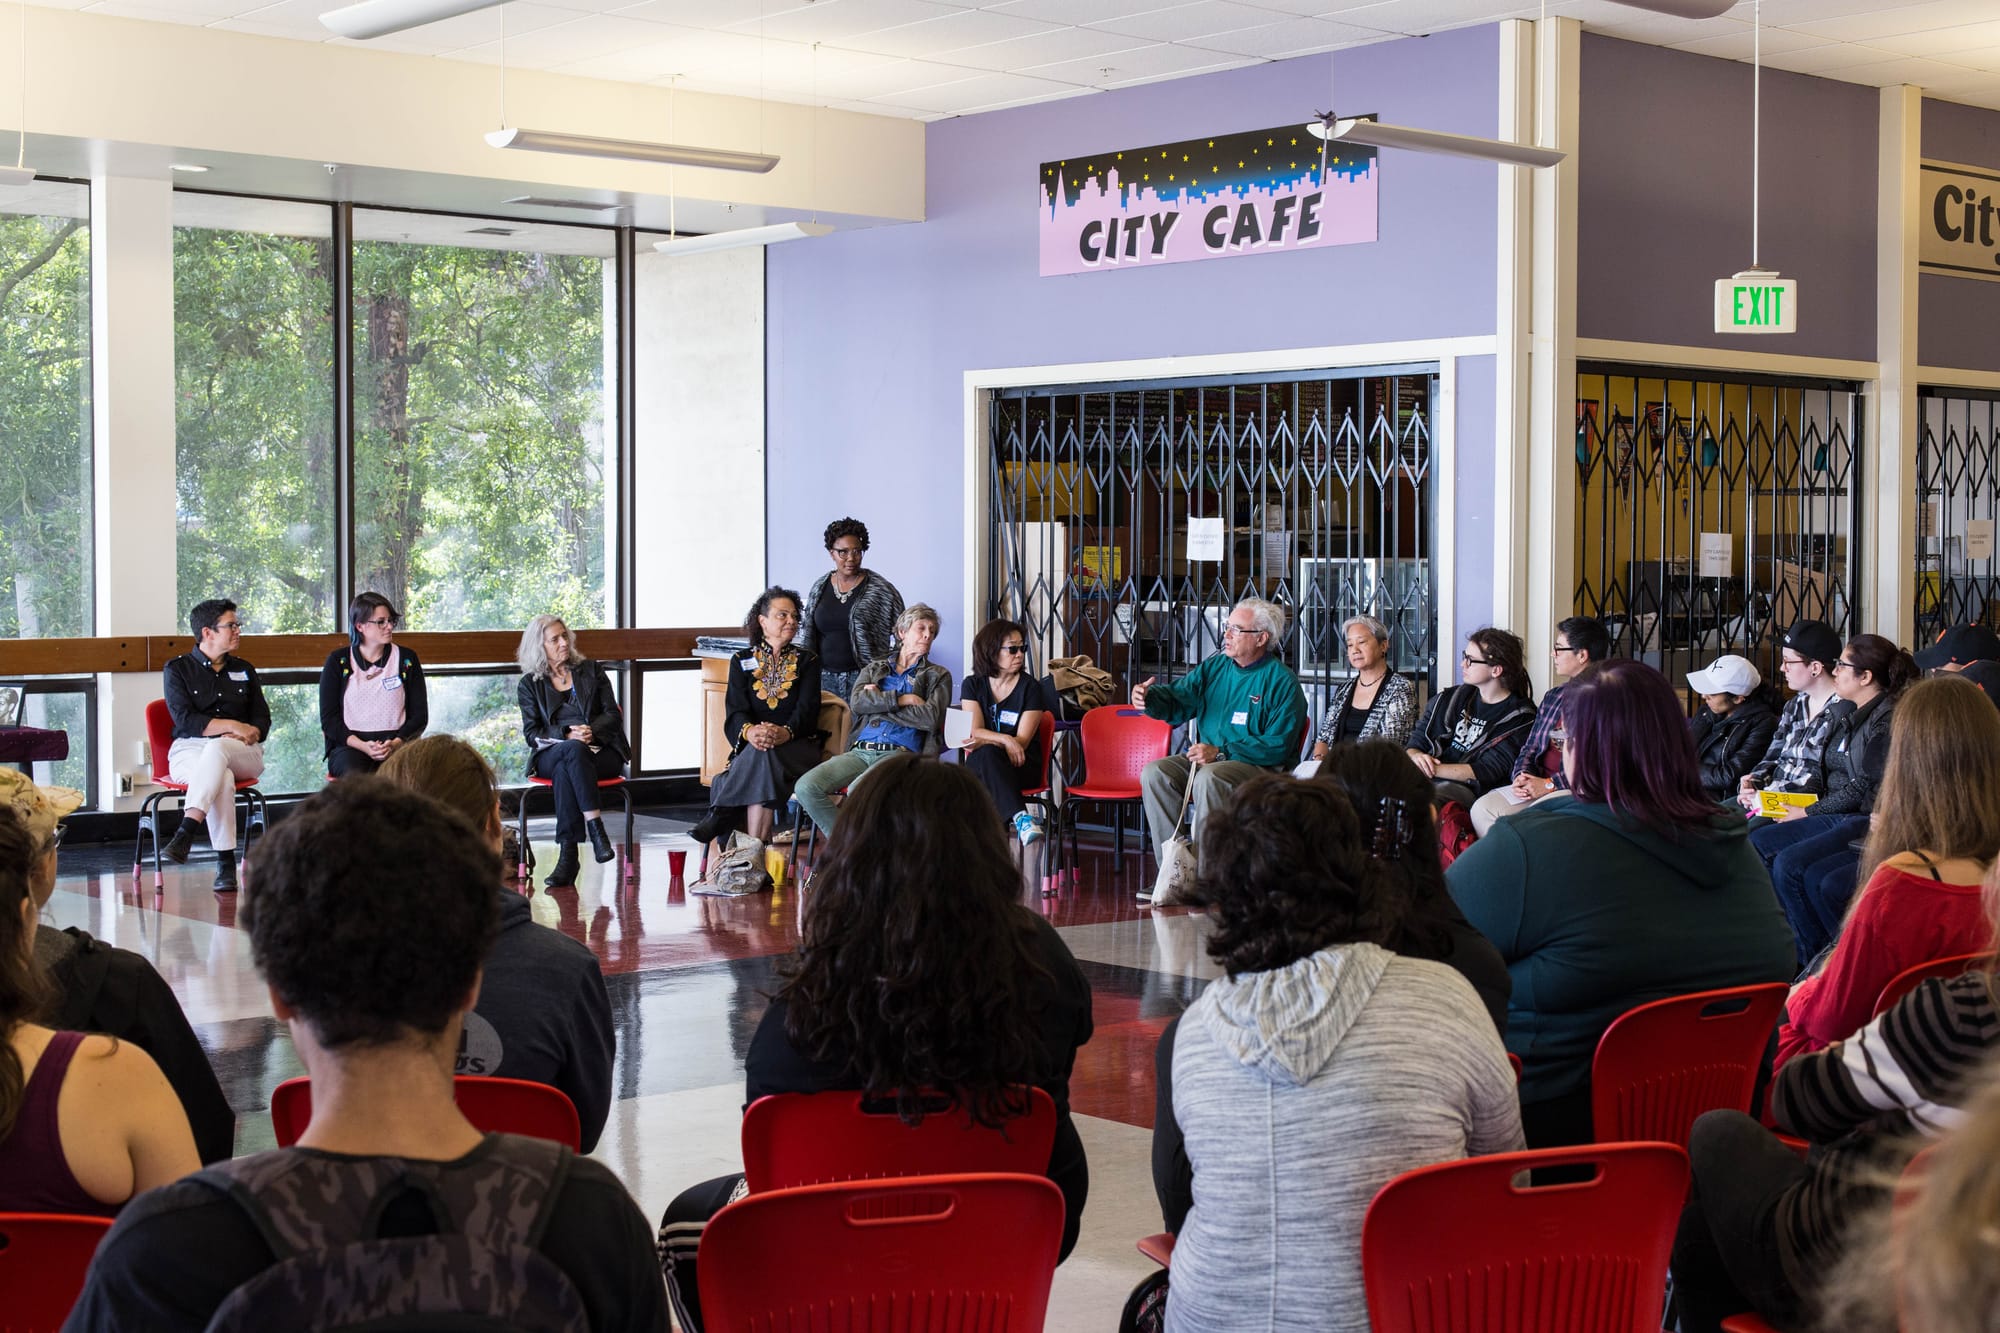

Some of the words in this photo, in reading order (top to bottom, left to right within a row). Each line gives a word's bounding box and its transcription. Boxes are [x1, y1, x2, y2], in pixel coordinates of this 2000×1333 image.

[1079, 211, 1181, 266] CITY
[1202, 191, 1327, 253] CAFE
[1933, 183, 2000, 266] Cit
[1733, 286, 1785, 326] EXIT
[1765, 791, 1782, 811] YOU
